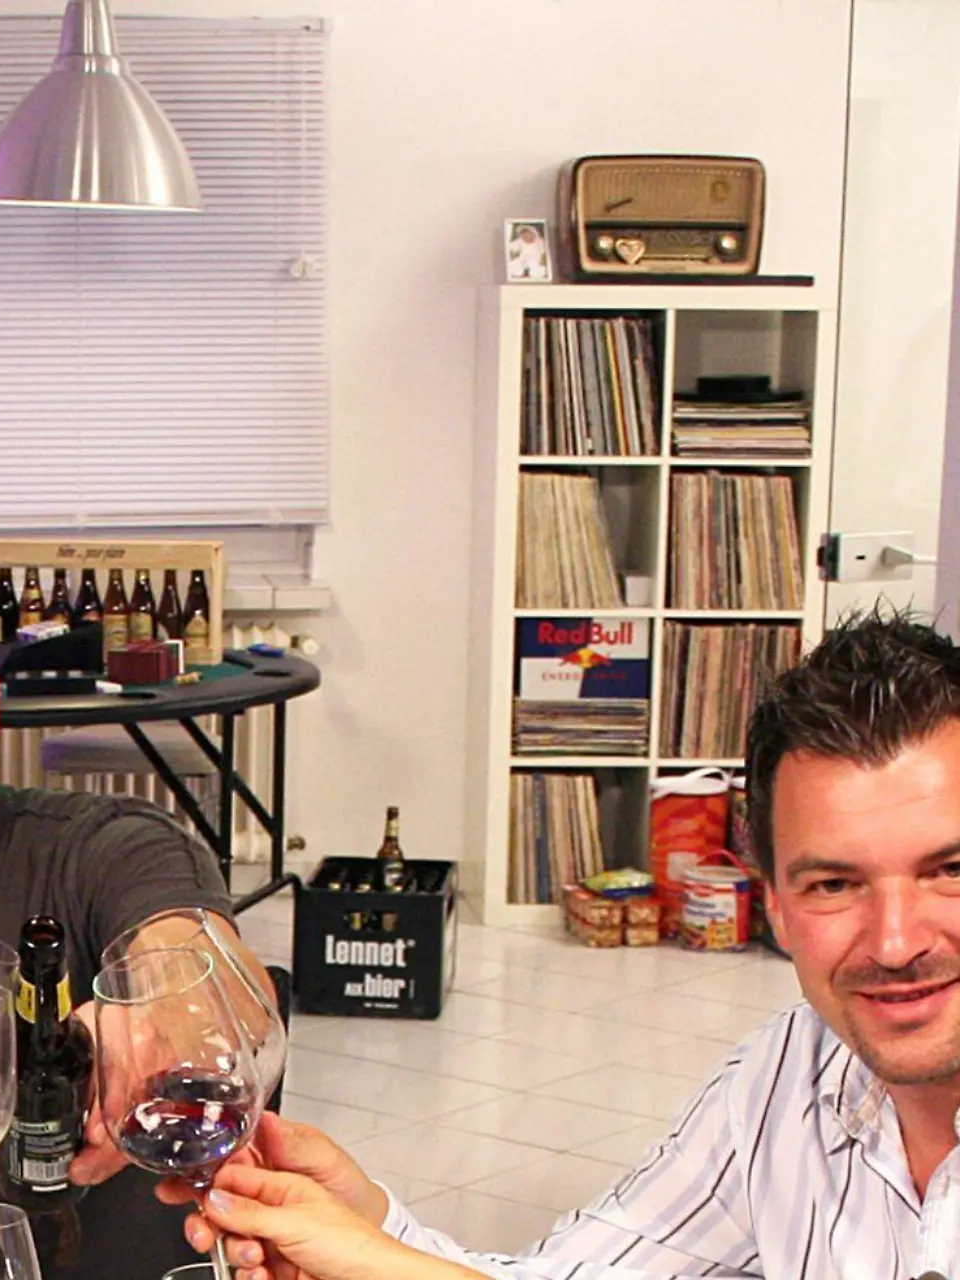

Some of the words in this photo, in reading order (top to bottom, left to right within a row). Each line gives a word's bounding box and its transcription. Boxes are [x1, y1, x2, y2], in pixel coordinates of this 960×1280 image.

[537, 620, 588, 645] Red
[590, 620, 634, 646] Bull
[541, 671, 589, 682] ENERG
[324, 933, 408, 968] Lennet
